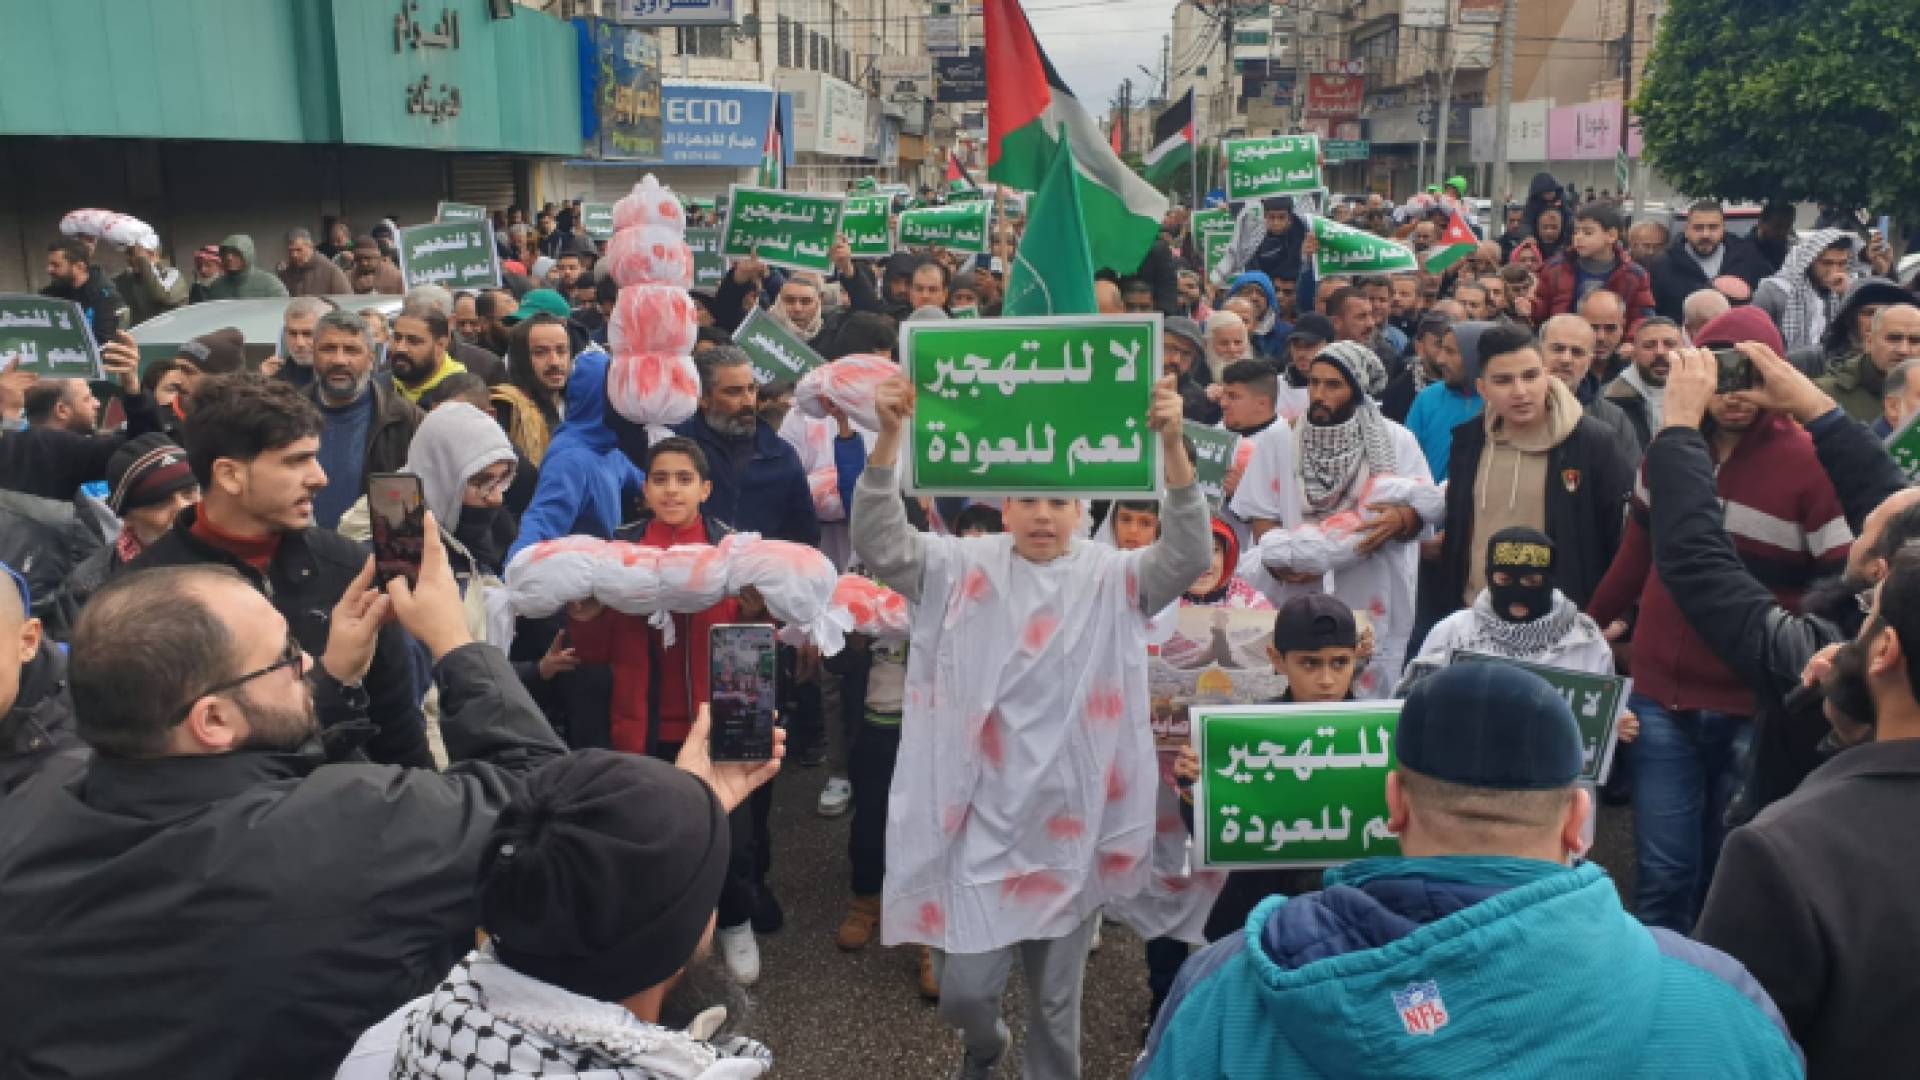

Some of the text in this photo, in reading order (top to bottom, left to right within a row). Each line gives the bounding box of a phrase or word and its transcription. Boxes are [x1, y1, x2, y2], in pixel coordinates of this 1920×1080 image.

[662, 97, 741, 126] ECNO
[1233, 138, 1294, 163] للتهجير
[1299, 137, 1311, 152] لا
[1233, 163, 1314, 190] نعم للعودة
[737, 202, 817, 225] للتهجير
[823, 207, 837, 225] لا
[731, 229, 792, 250] للعودة
[904, 218, 982, 245] نعم للعودة
[793, 237, 828, 260] نعم
[1322, 243, 1376, 267] للعودة
[53, 310, 73, 330] لا
[47, 345, 89, 369] نعم
[922, 338, 1141, 399] لا للتهجير
[926, 415, 1142, 478] نعم للعودة
[1581, 690, 1602, 717] لا
[1214, 725, 1391, 785] للتهجير
[1219, 804, 1353, 852] للعودة
[1403, 1001, 1445, 1033] NFL
